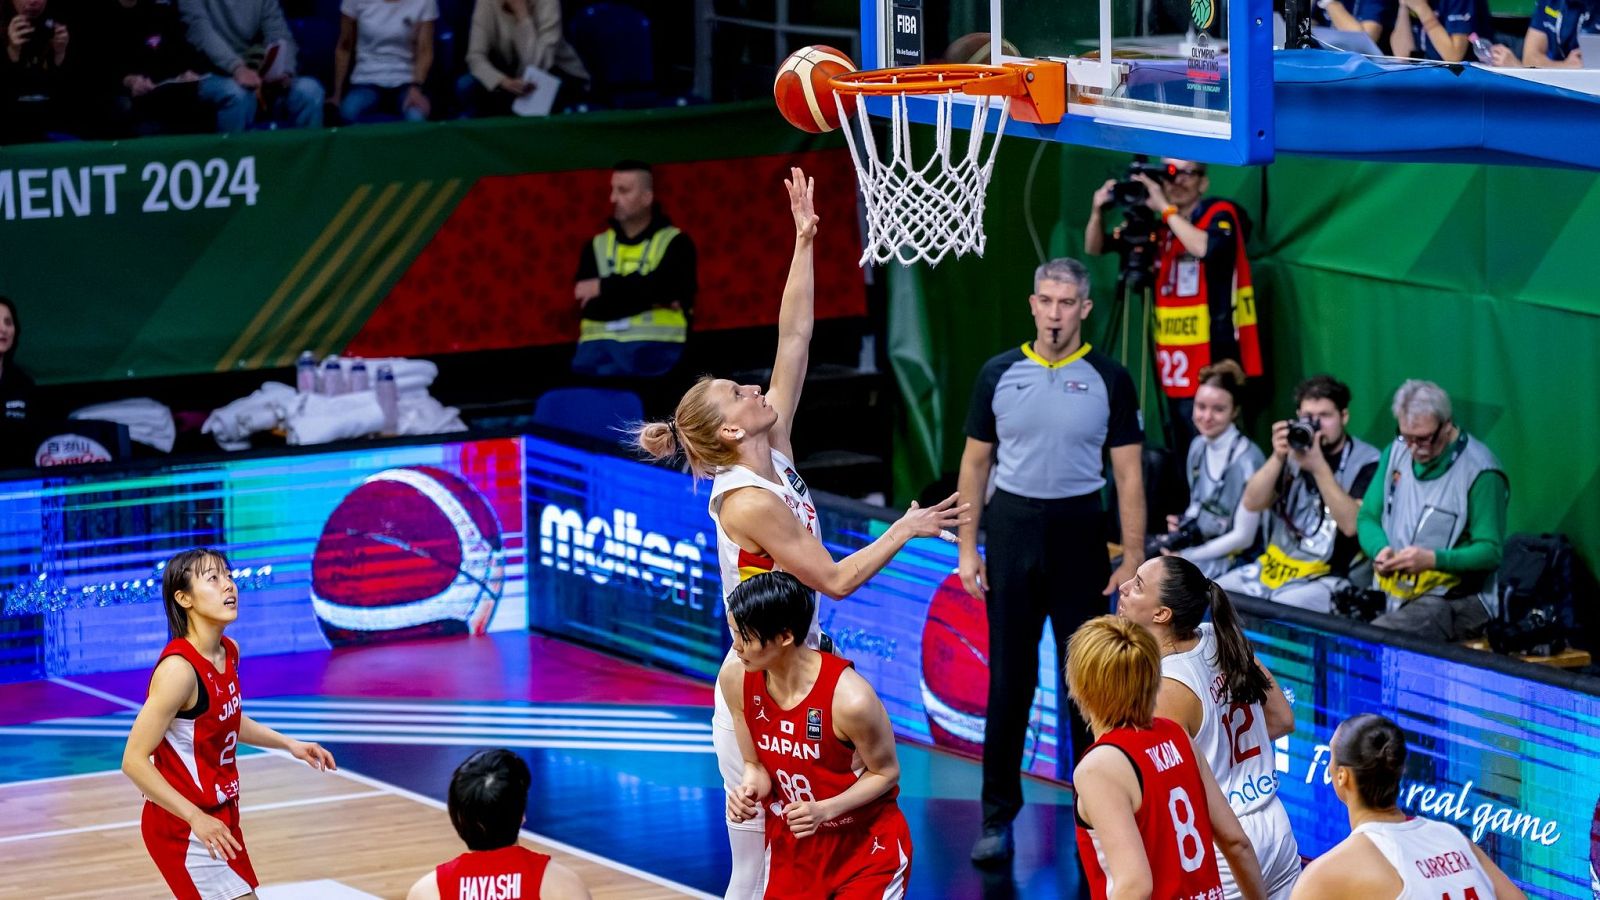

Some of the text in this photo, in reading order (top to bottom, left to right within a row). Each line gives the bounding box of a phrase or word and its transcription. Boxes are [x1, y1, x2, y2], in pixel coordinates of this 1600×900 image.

[897, 14, 917, 35] FIBA
[1187, 58, 1219, 72] QUALIFYING
[1191, 47, 1215, 60] OLYMPIC
[141, 156, 260, 212] 2024
[220, 730, 238, 766] 2
[757, 734, 821, 760] JAPAN
[1222, 701, 1261, 769] 12
[776, 768, 816, 802] 88
[1405, 780, 1473, 821] real
[1472, 800, 1562, 846] game
[1168, 786, 1206, 873] 8
[1415, 850, 1474, 879] CARRERA
[459, 872, 522, 900] HAYASHI
